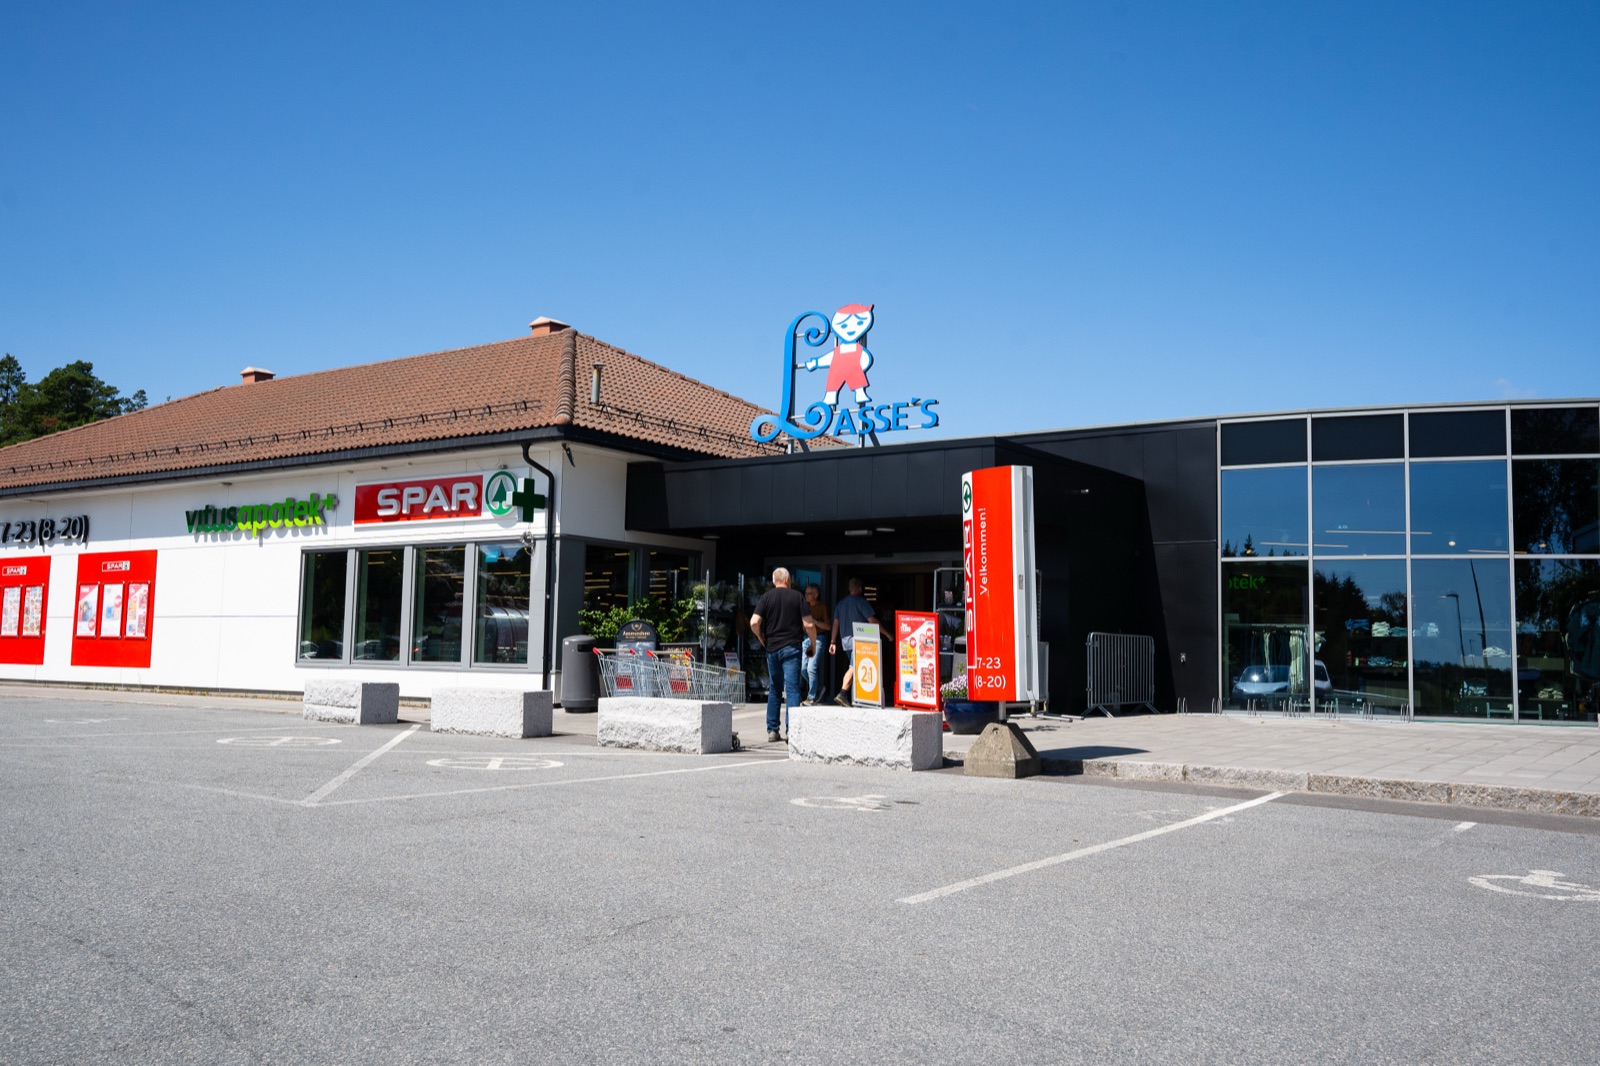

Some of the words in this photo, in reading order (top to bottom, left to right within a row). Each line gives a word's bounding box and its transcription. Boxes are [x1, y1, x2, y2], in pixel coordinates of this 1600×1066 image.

[376, 481, 478, 517] SPAR
[978, 507, 988, 596] Velkommen!
[964, 524, 973, 632] SPAR
[977, 656, 1001, 669] 7-23
[975, 674, 1006, 690] (8-20)
